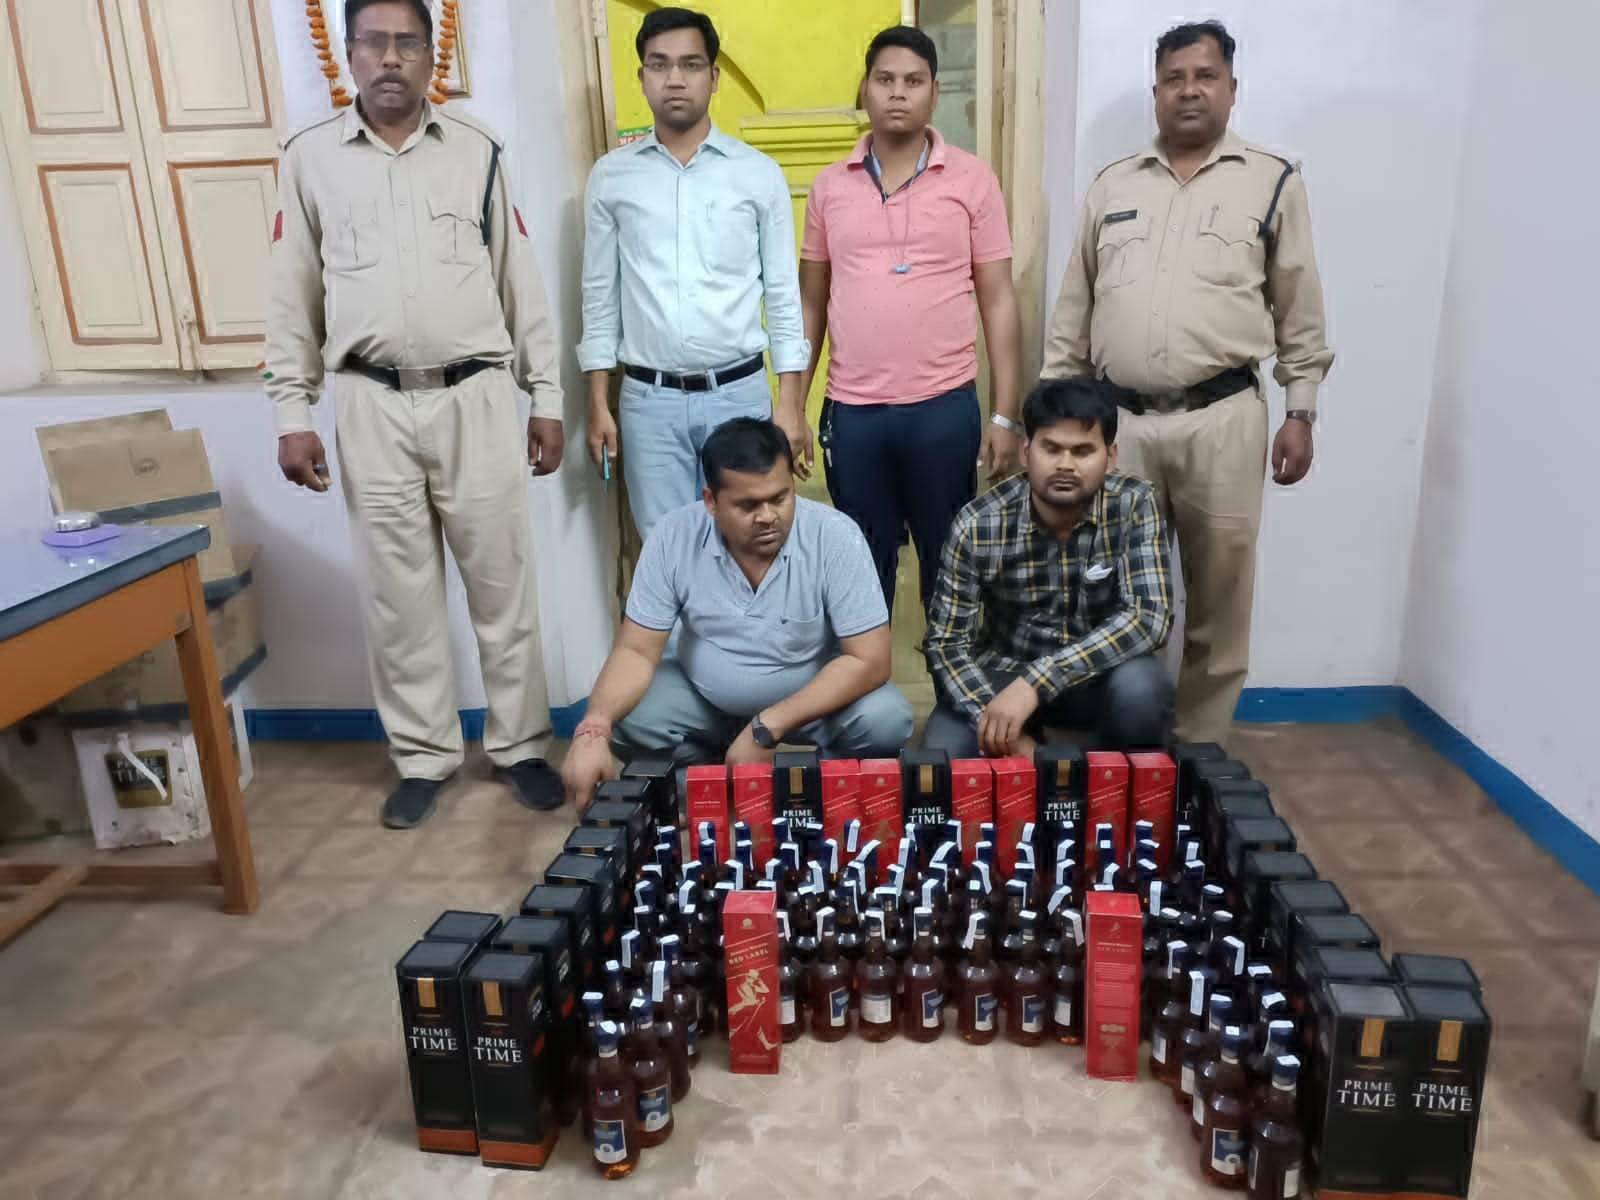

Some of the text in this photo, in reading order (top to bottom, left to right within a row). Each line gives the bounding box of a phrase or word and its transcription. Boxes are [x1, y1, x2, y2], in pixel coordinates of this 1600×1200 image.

[912, 806, 942, 814] PRIME
[1047, 801, 1078, 810] PRIME
[782, 809, 813, 817] PRIME
[908, 813, 945, 825] TIME
[1043, 810, 1081, 821] TIME
[412, 1026, 452, 1037] PRIME
[408, 1035, 458, 1051] TIME
[477, 1036, 518, 1048] PRIME
[473, 1046, 523, 1063] TIME
[1344, 1079, 1393, 1092] PRIME
[1419, 1082, 1470, 1097] PRIME
[1336, 1089, 1397, 1108] TIME
[1411, 1093, 1473, 1112] TIME
